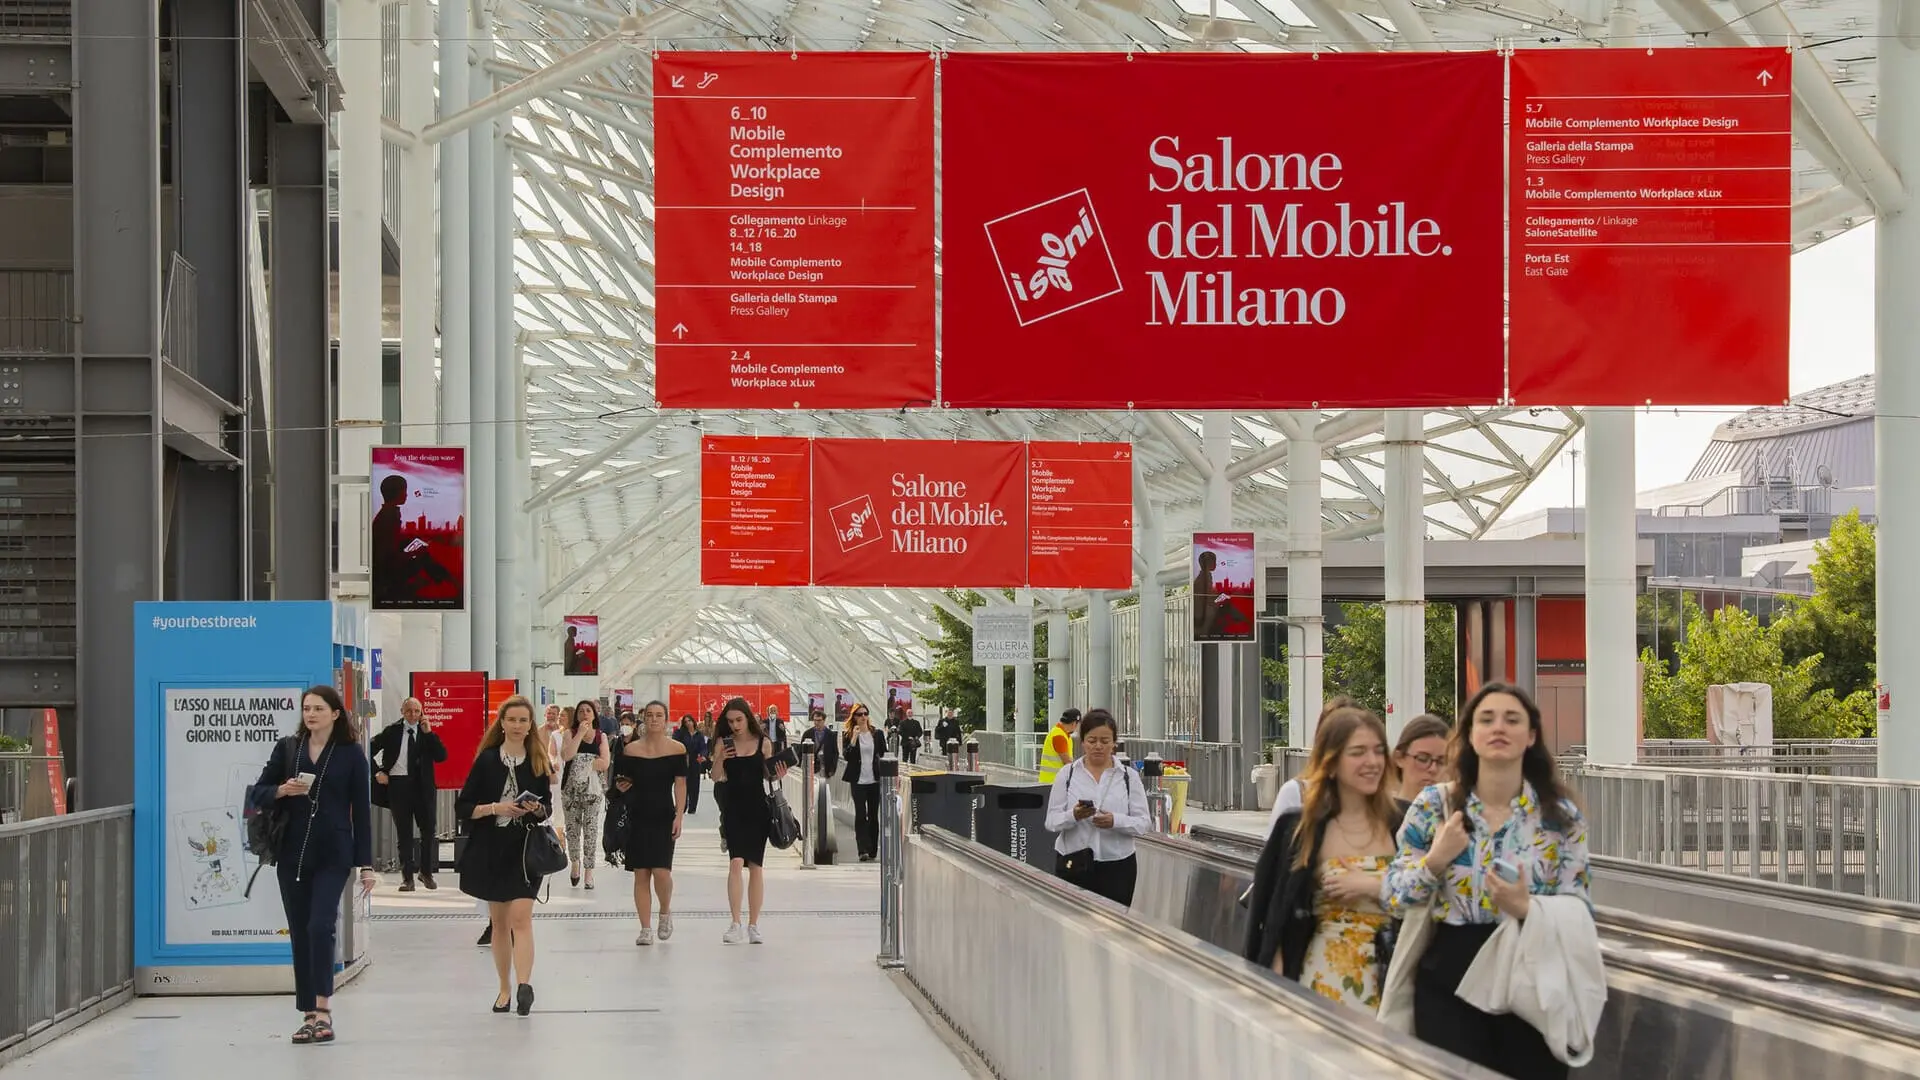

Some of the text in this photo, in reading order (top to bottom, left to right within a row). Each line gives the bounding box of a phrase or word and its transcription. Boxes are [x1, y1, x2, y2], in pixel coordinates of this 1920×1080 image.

[731, 106, 767, 120] 6_10
[1526, 104, 1543, 113] 5_7
[1526, 117, 1738, 130] Mobile Complemento Workplace Design
[731, 126, 785, 140] Mobile
[1526, 141, 1633, 152] Galleria della Stampa
[730, 145, 842, 161] Complemento
[1150, 136, 1342, 192] Salone
[1527, 154, 1585, 166] Press Gallery
[730, 164, 820, 182] Workplace
[1526, 177, 1544, 186] 1_3
[731, 183, 784, 201] Design
[1526, 188, 1722, 201] Mobile Complemento Workplace xLux
[730, 215, 847, 227] Collegamento Linkage
[1526, 216, 1594, 227] Collegamento
[1603, 216, 1638, 227] Linkage
[730, 228, 755, 238] 8_12
[764, 228, 796, 238] 16_20
[1148, 202, 1452, 259] del Mobile.
[1525, 228, 1597, 237] SaloneSatellite
[730, 242, 762, 253] 14_18
[731, 257, 842, 269] Mobile Complemento
[1525, 254, 1569, 263] Porta Est
[730, 270, 823, 282] Workplace Design
[1525, 267, 1568, 276] East Gate
[731, 293, 837, 304] Galleria della Stampa
[1145, 271, 1345, 326] Milano
[731, 306, 789, 318] Press Gallery
[731, 351, 750, 360] 2_4
[731, 364, 844, 375] Mobile Complemento
[731, 377, 815, 389] Workplace xLux
[419, 454, 440, 463] design
[731, 472, 775, 480] Complemento
[1032, 478, 1074, 486] Complemento
[731, 480, 766, 489] Workplace
[892, 473, 966, 498] Salone
[731, 489, 752, 497] Design
[892, 502, 1007, 526] del Mobile.
[891, 529, 967, 553] Milano
[153, 616, 256, 630] #yourbestbreak
[976, 641, 1030, 651] GALLERIA
[424, 688, 448, 699] 6_10
[214, 698, 245, 711] NELLA
[249, 698, 294, 710] MANICA
[194, 714, 274, 726] DI CHI LAVORA
[186, 728, 279, 744] GIORNO E NOTTE
[1010, 814, 1018, 857] ERENZIATA
